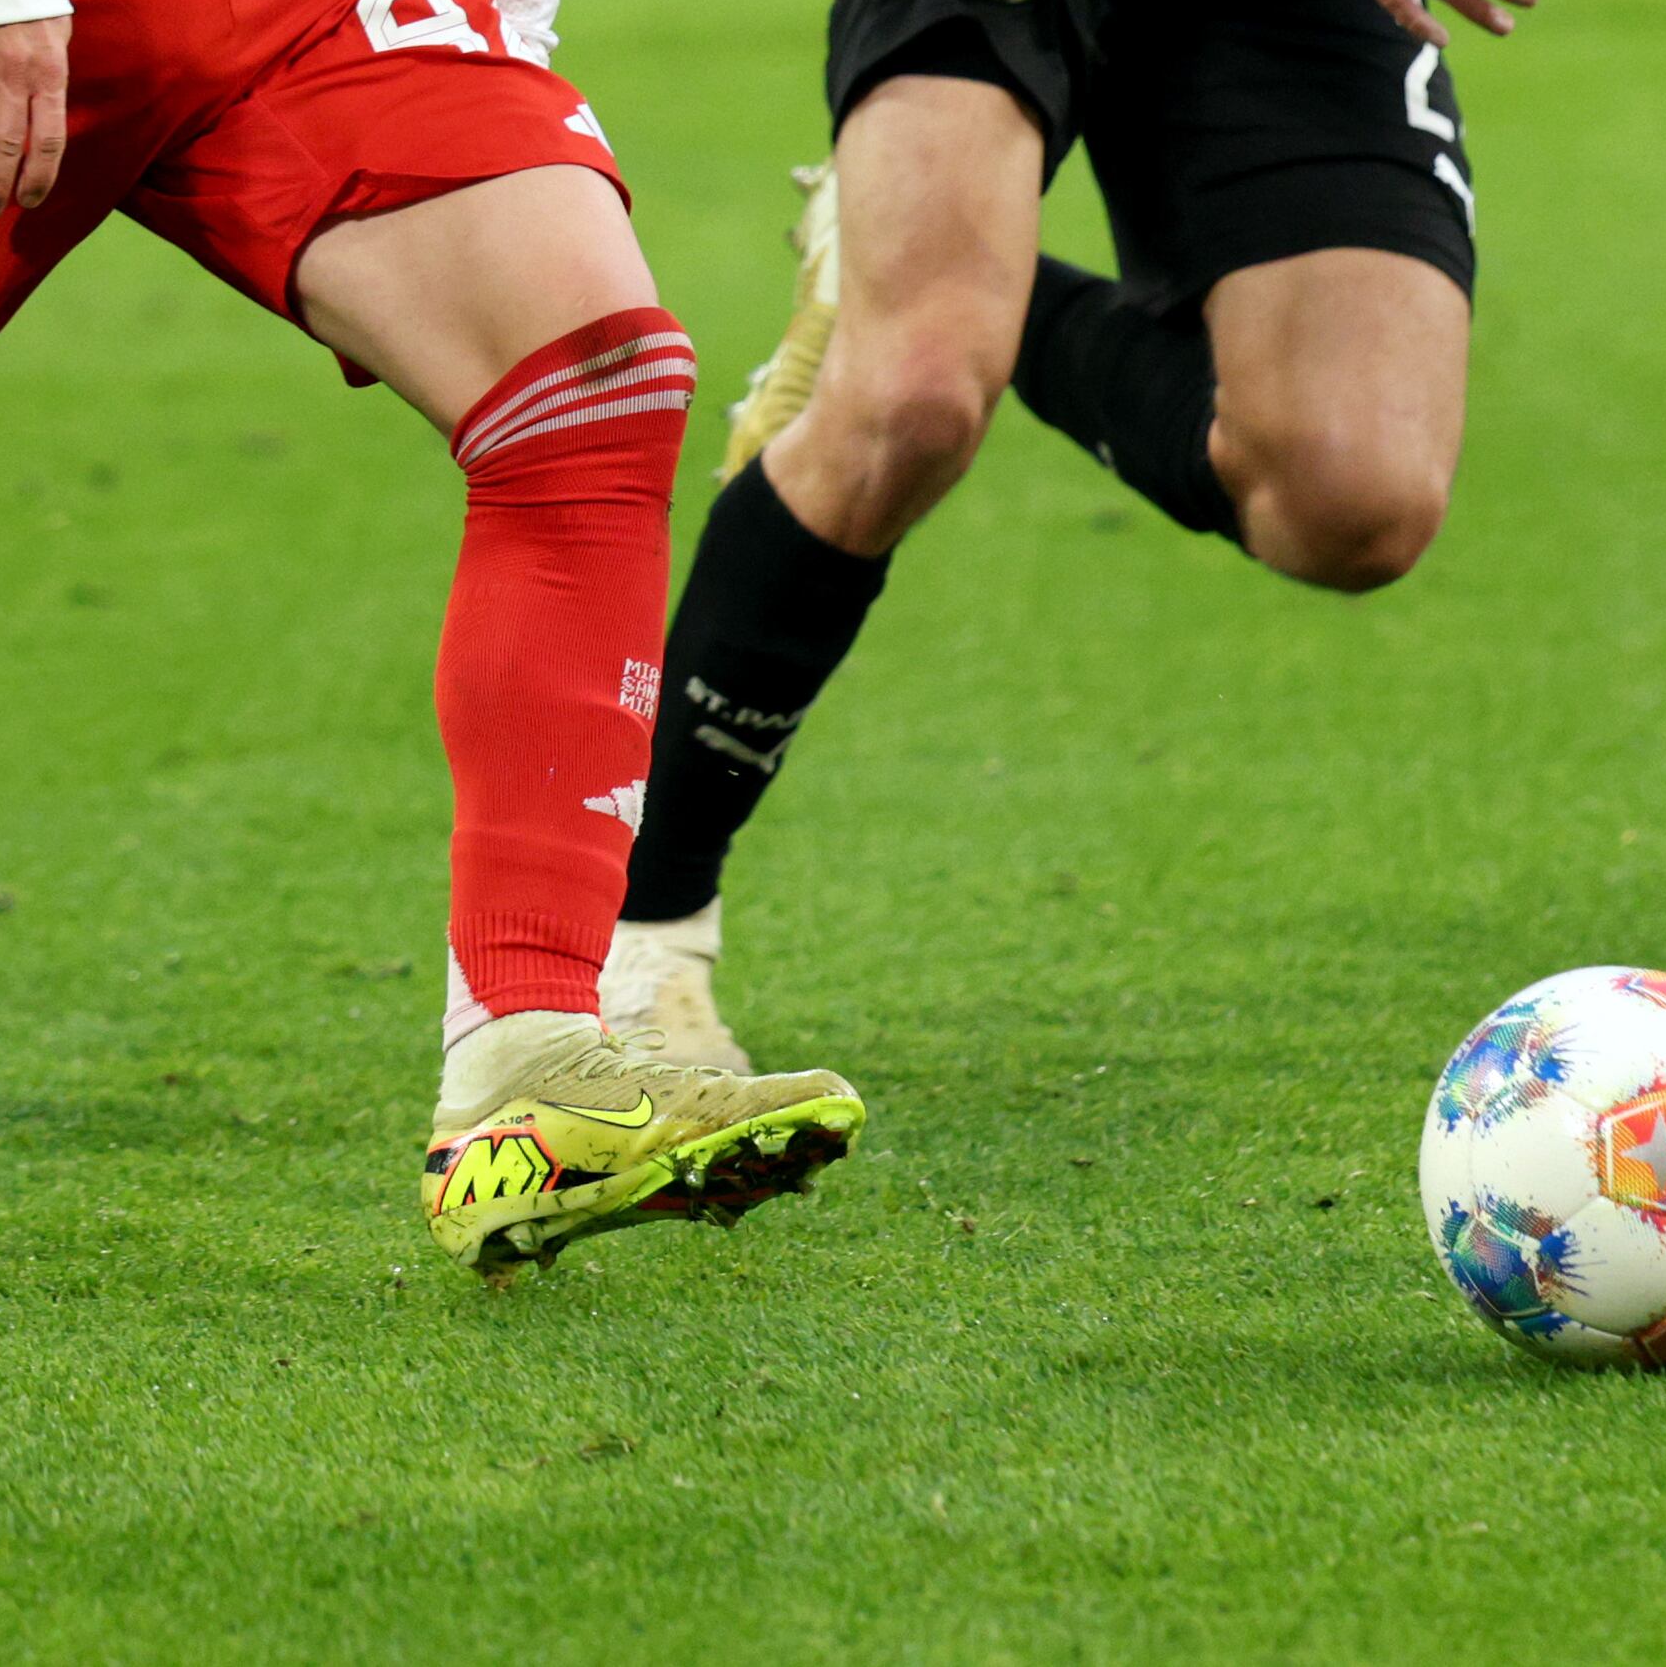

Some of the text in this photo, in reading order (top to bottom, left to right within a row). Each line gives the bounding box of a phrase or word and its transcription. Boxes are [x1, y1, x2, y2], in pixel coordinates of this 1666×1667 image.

[623, 657, 661, 686] MIA
[620, 675, 659, 703] SAN
[619, 690, 656, 720] MIA
